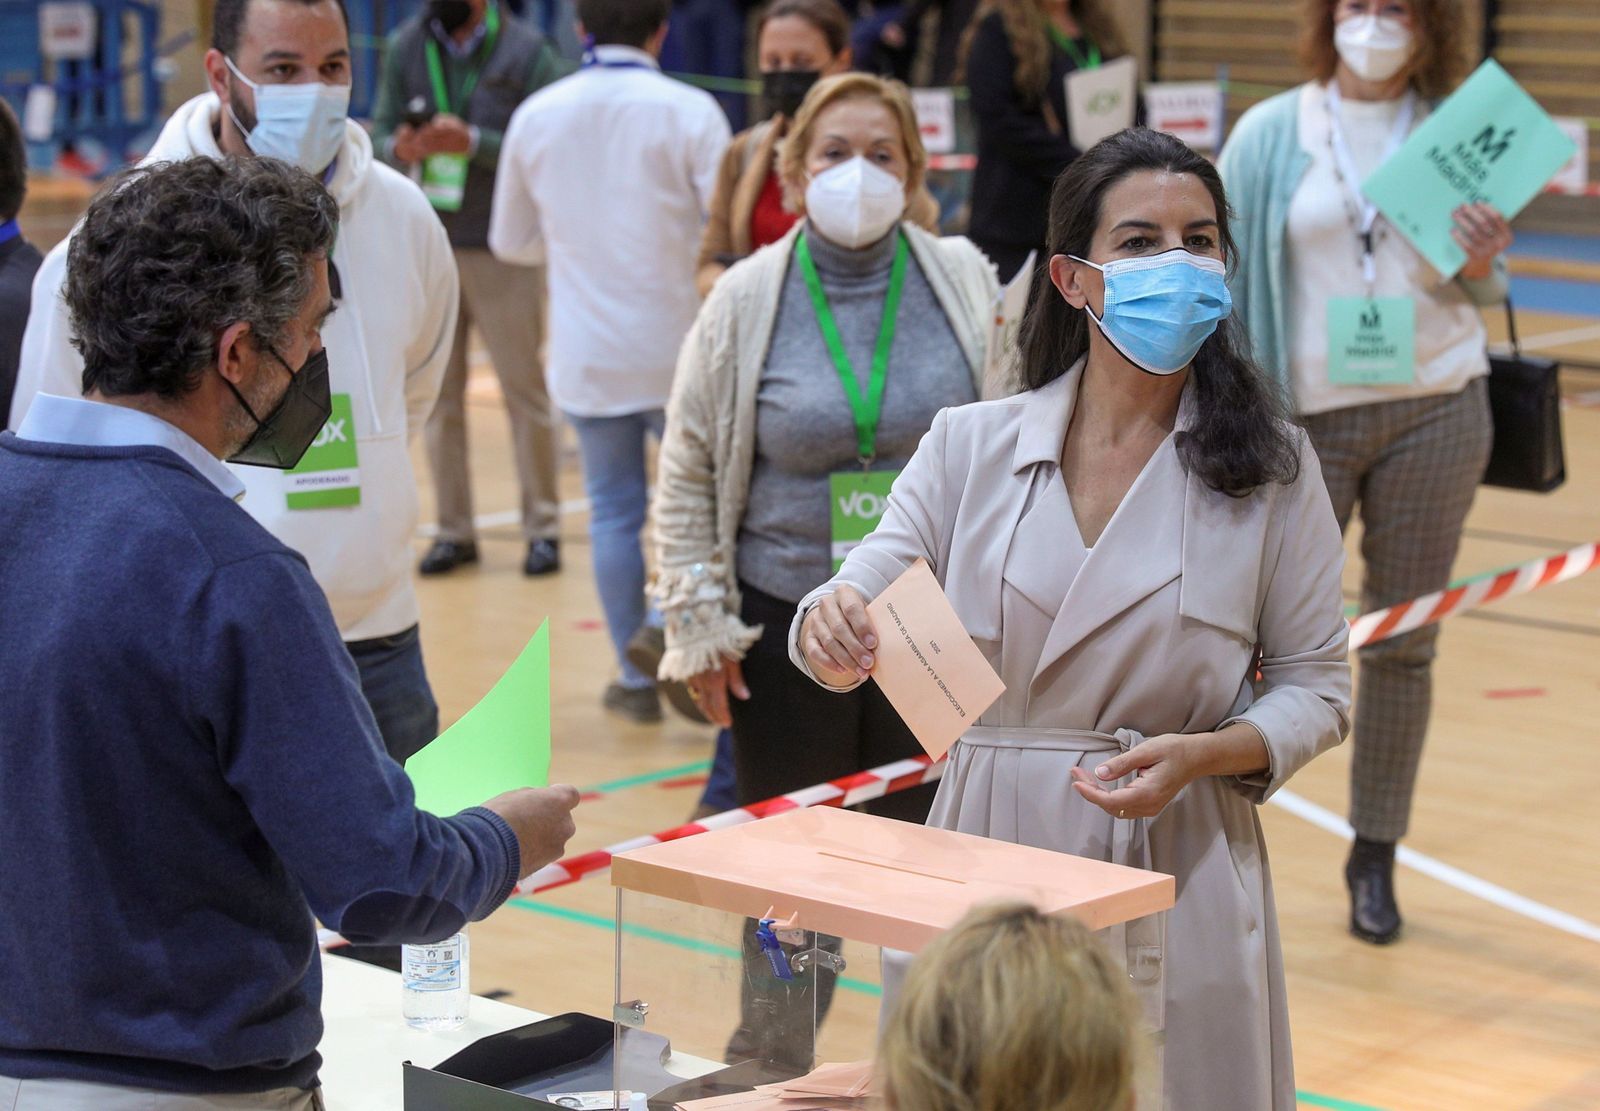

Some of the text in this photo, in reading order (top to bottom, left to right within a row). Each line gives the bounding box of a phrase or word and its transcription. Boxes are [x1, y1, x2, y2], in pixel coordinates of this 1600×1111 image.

[887, 602, 902, 626] MADRID
[900, 626, 907, 635] DE
[905, 634, 928, 666] ASAMBLEA
[930, 640, 941, 654] 2021
[937, 680, 965, 717] ELECCIONES
